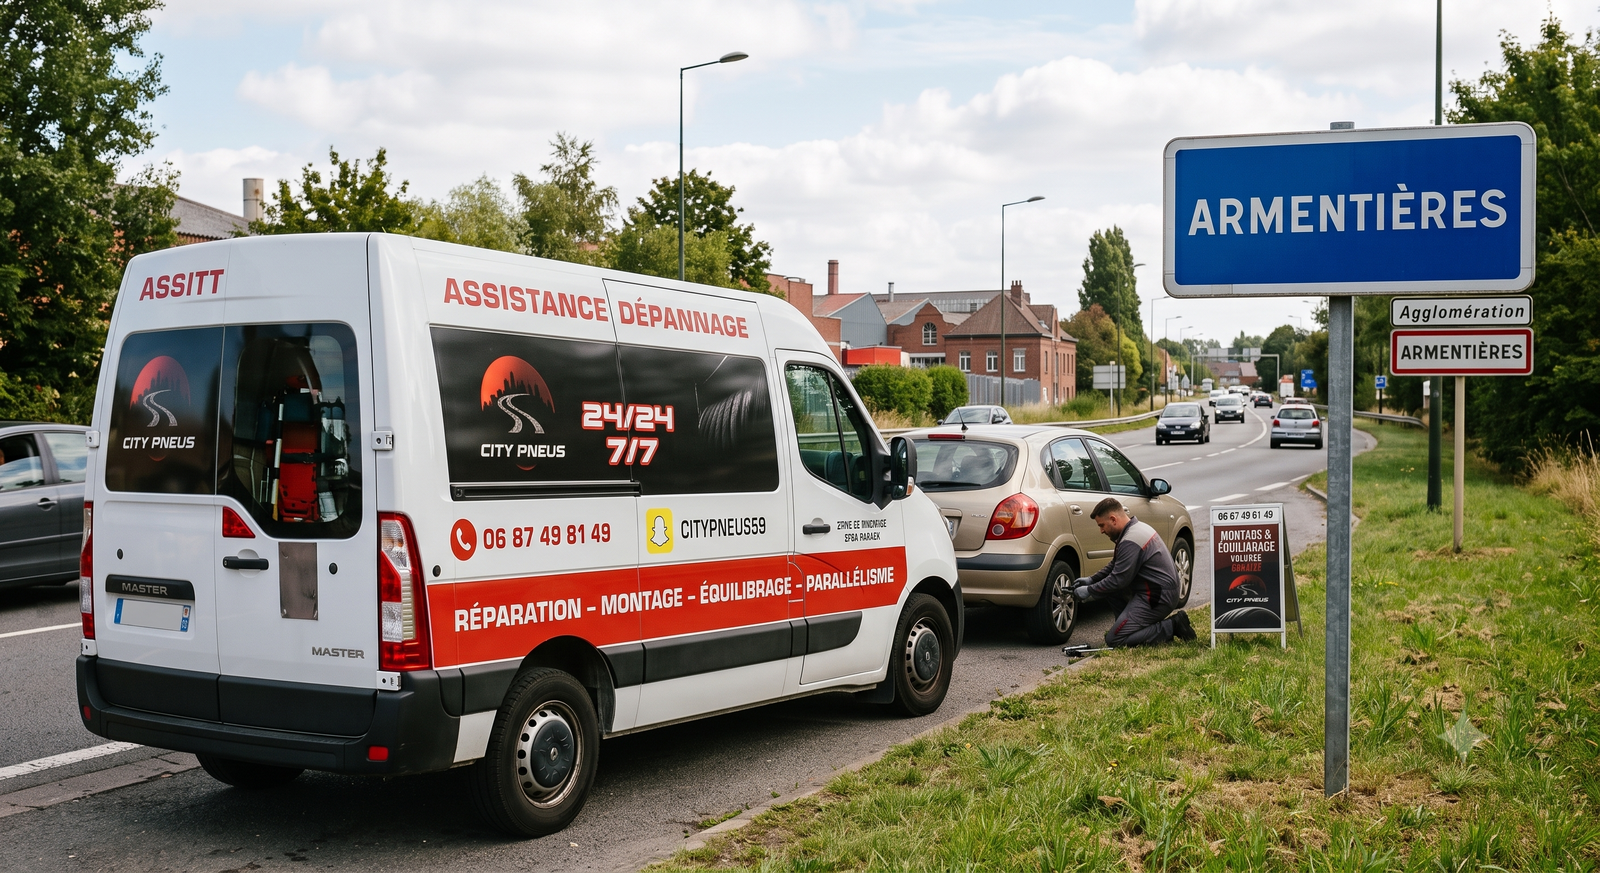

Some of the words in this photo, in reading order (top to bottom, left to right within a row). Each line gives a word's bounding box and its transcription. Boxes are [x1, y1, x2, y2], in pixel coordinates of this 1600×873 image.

[1188, 183, 1508, 236] ARMENTIÈRES
[139, 269, 225, 301] ASSITT
[443, 277, 609, 322] ASSISTANCE
[618, 296, 749, 339] DÉPANNAGE
[1399, 305, 1525, 323] Agglomération
[1401, 341, 1523, 360] ARMENTIÈRES
[582, 401, 675, 432] 24/24
[122, 436, 149, 449] CITY
[151, 435, 196, 449] PNEUS
[480, 444, 514, 458] CITY
[517, 444, 566, 458] PNEUS
[605, 437, 660, 467] 7/7
[1241, 511, 1251, 520] 49
[1264, 510, 1274, 519] 49
[483, 528, 506, 549] 06
[512, 526, 534, 548] 87
[540, 525, 561, 546] 49
[566, 523, 586, 545] 81
[591, 522, 611, 543] 49
[681, 516, 766, 539] CITYPNEUS59
[1264, 529, 1272, 540] &
[121, 582, 168, 596] MASTER
[454, 598, 582, 632] RÉPARATION
[601, 587, 683, 616] MONTAGE
[700, 576, 792, 604] ÉQUILIBRAGE
[806, 566, 895, 592] PARALLÉLISME
[311, 646, 365, 659] MASTER
